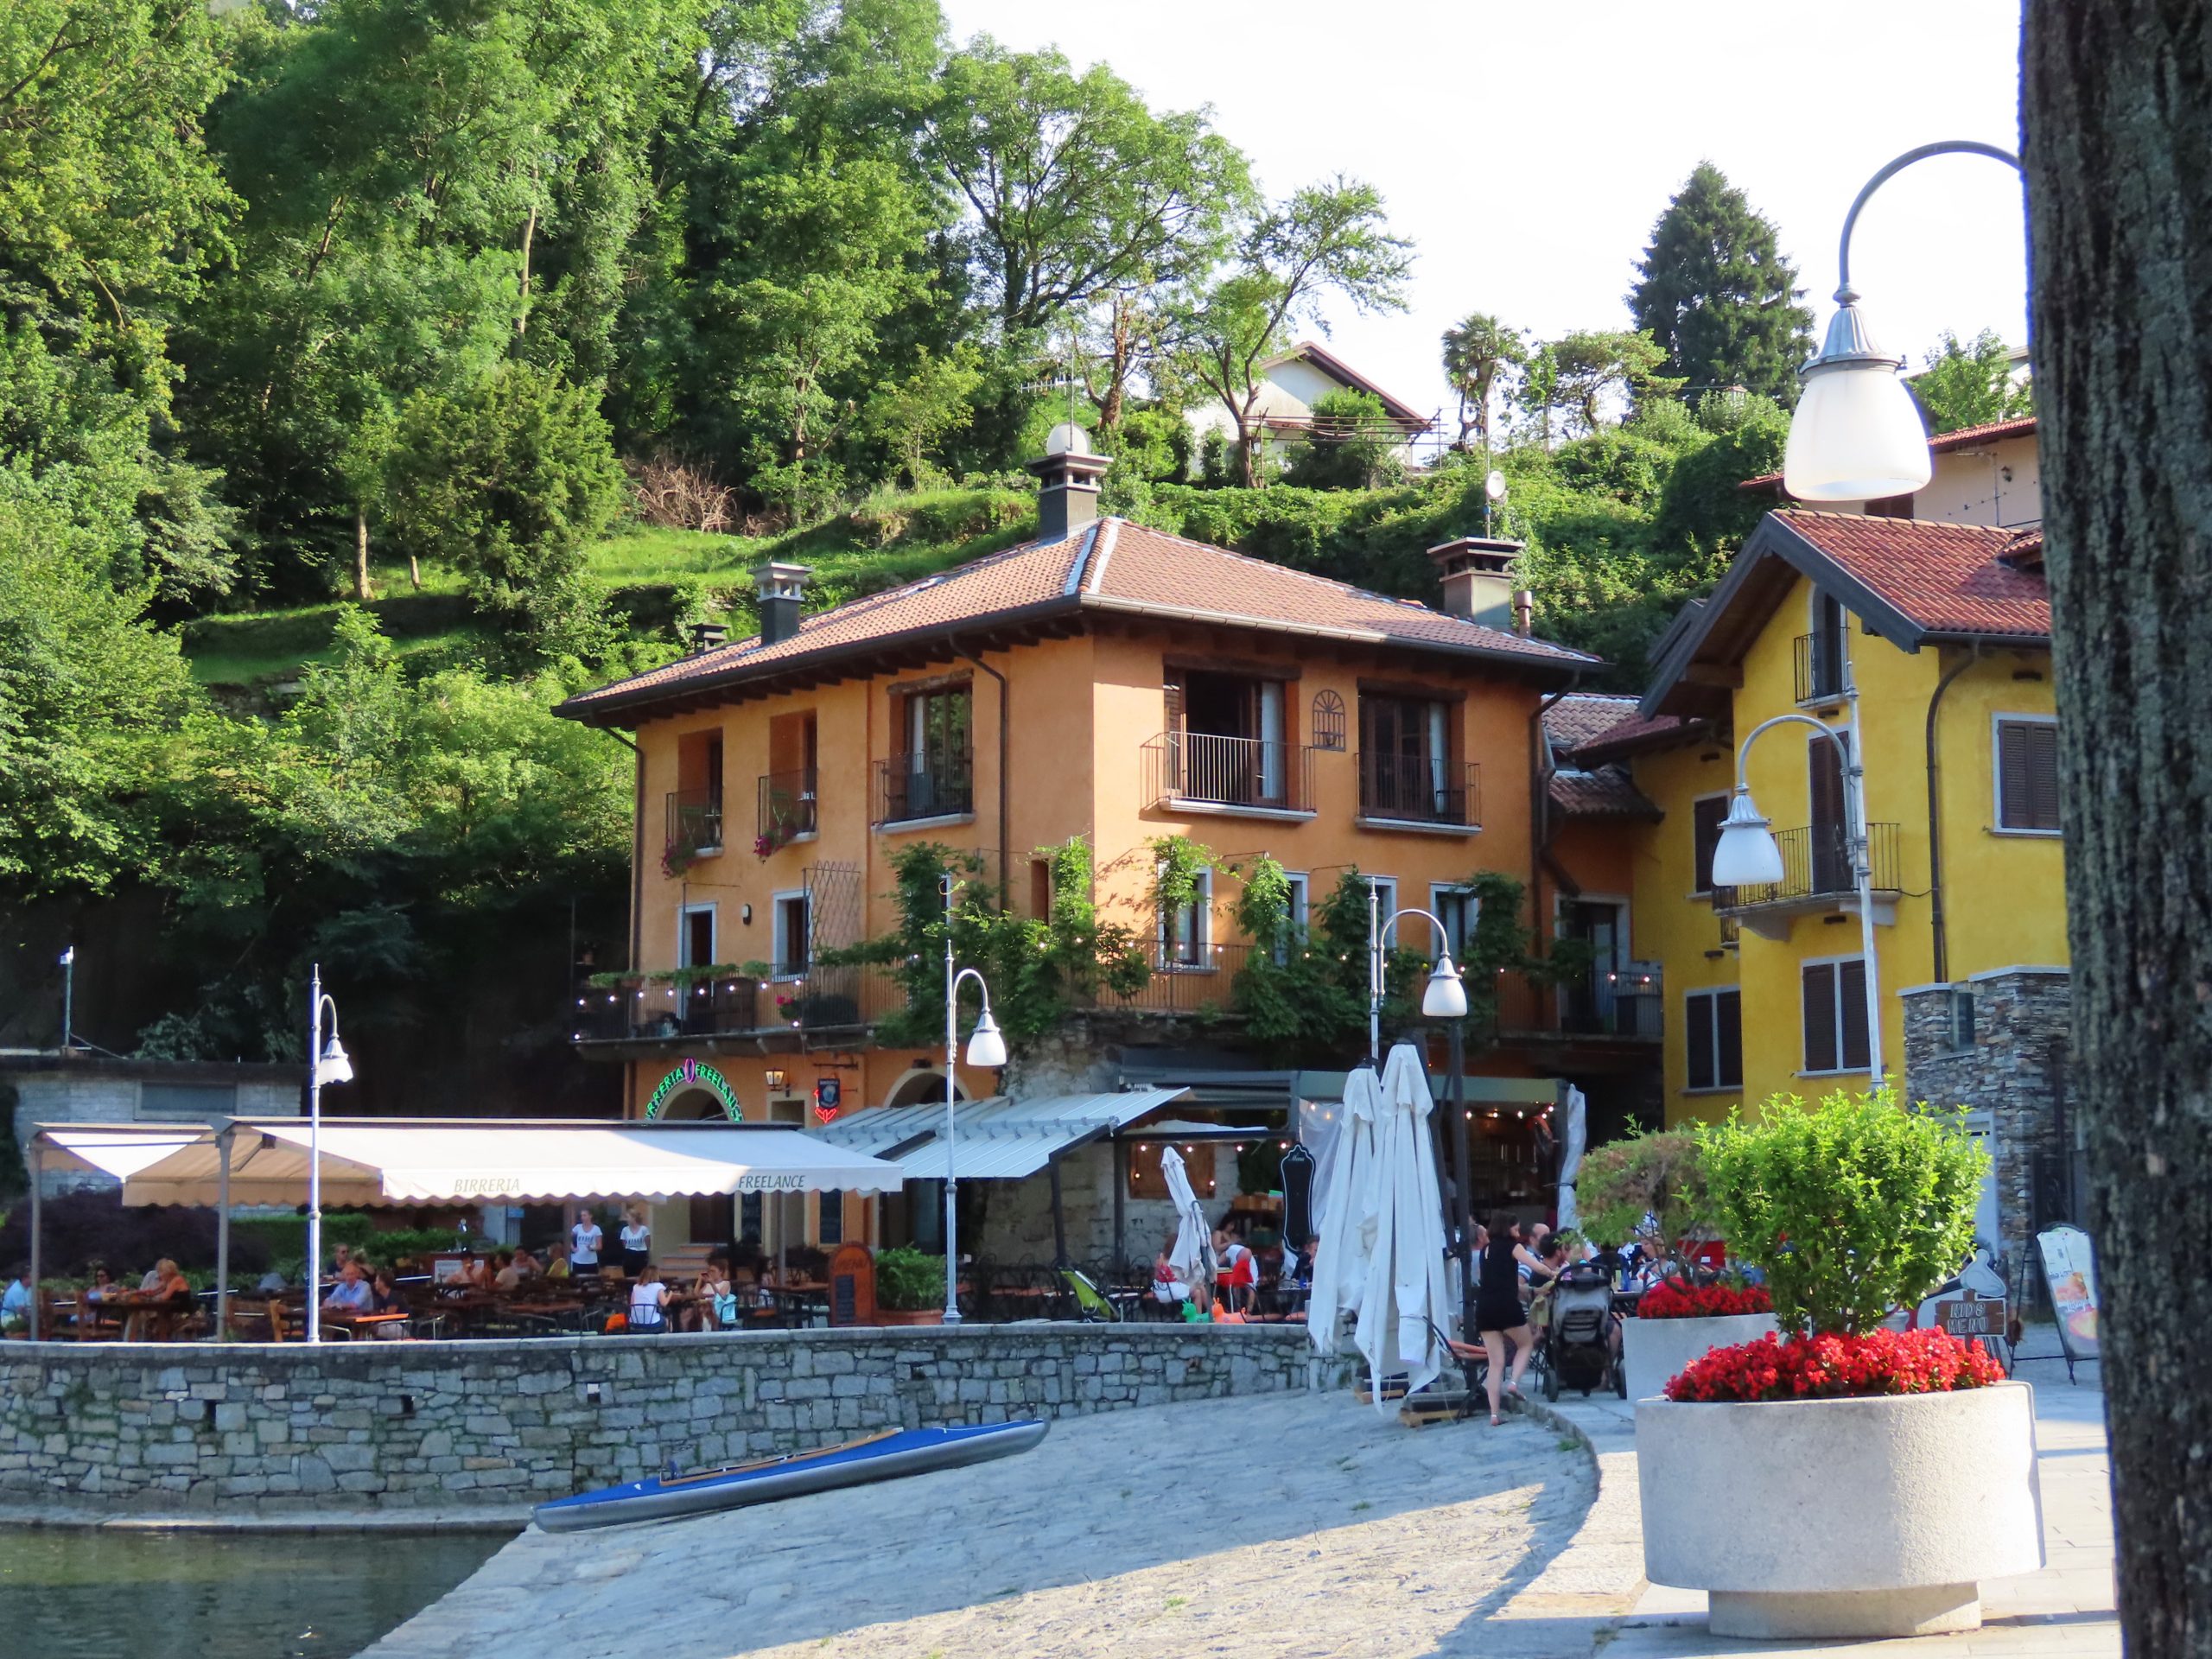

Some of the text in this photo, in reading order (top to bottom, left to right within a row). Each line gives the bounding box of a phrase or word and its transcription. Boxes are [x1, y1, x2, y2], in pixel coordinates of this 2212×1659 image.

[645, 1066, 684, 1119] IRRERIA
[454, 1175, 805, 1192] BIRRERIA FREELANCE
[1950, 1302, 1986, 1318] KIDS
[1947, 1317, 1987, 1333] MENU
